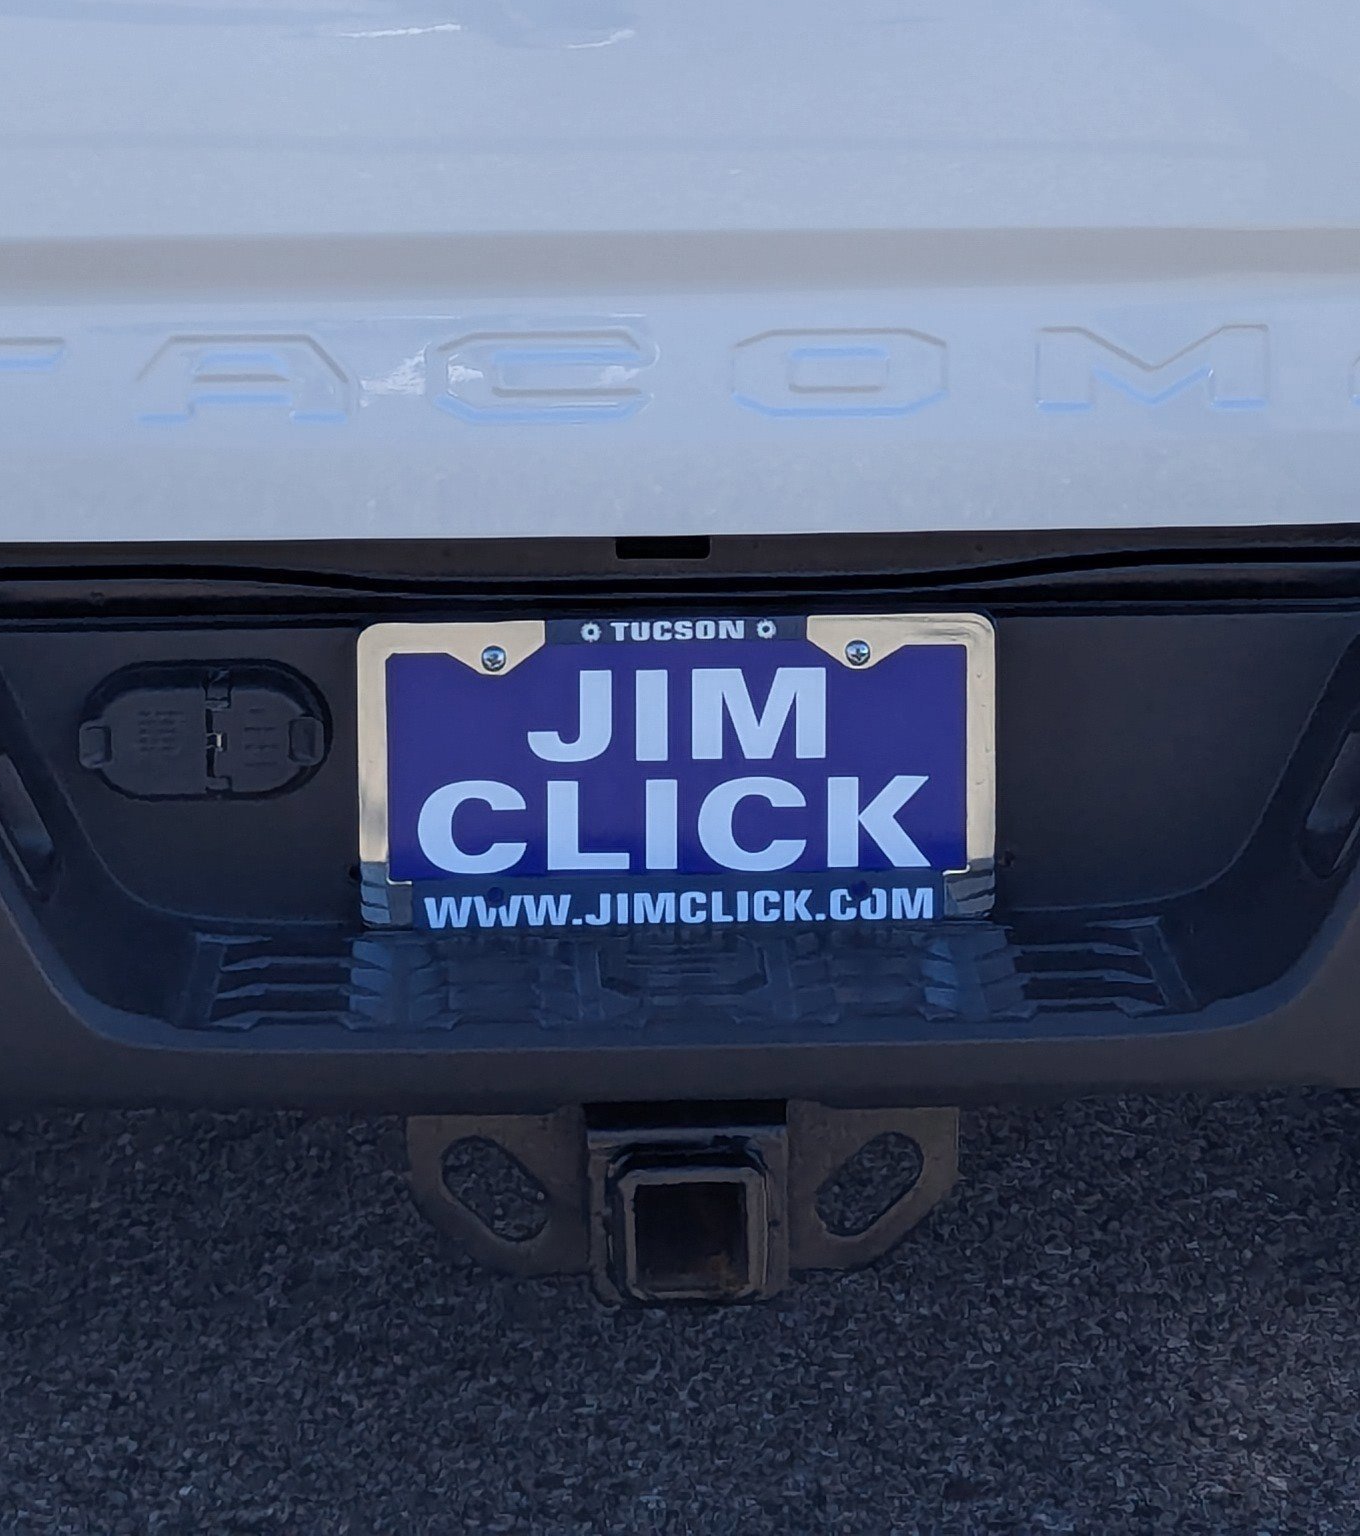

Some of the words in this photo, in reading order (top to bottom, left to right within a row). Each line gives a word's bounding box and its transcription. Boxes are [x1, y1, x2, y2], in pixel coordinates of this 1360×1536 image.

[610, 620, 745, 642] TUCSON
[527, 667, 827, 763] JIM
[417, 775, 931, 875] CLICK
[424, 887, 934, 930] WWW.JIMCLICK.COM
